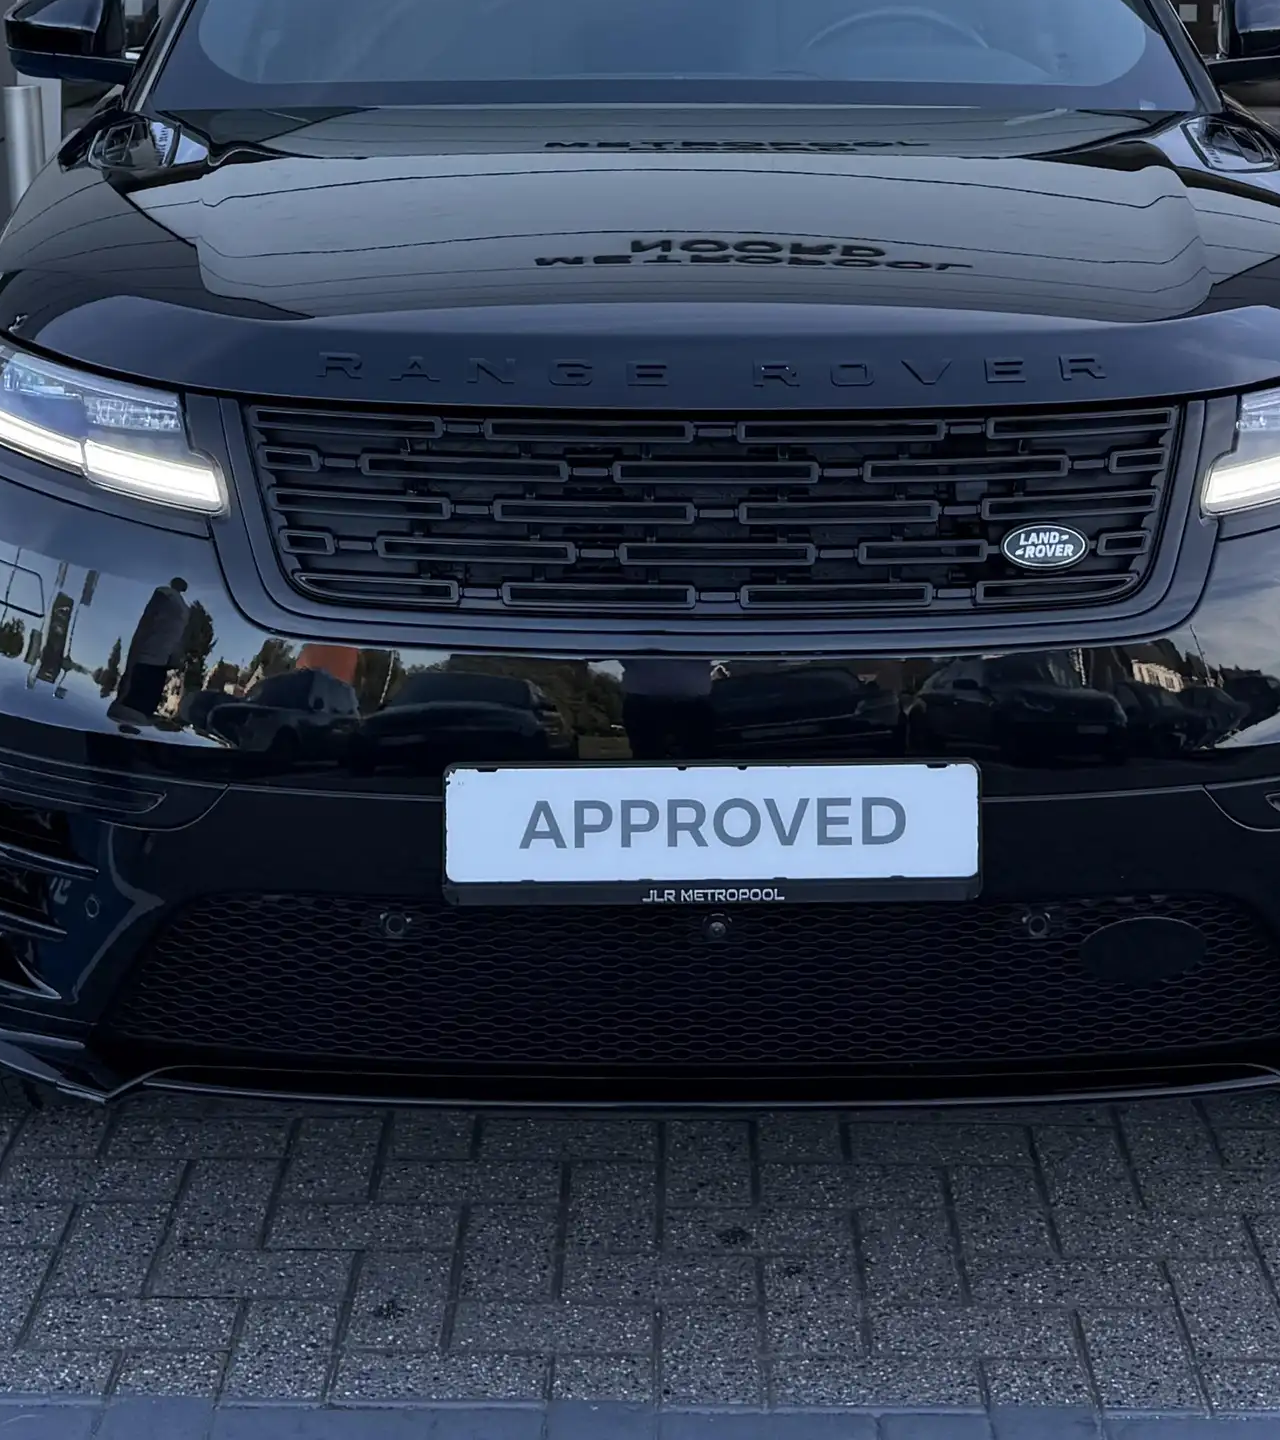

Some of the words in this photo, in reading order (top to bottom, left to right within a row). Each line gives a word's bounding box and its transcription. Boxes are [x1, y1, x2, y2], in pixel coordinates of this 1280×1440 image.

[316, 351, 668, 387] RANGE
[752, 353, 1108, 388] ROVER
[1019, 531, 1060, 546] LAND
[1024, 543, 1074, 558] ROVER
[519, 796, 907, 850] APPROVED
[642, 888, 676, 903] JLR
[681, 887, 785, 902] METROPOOL
